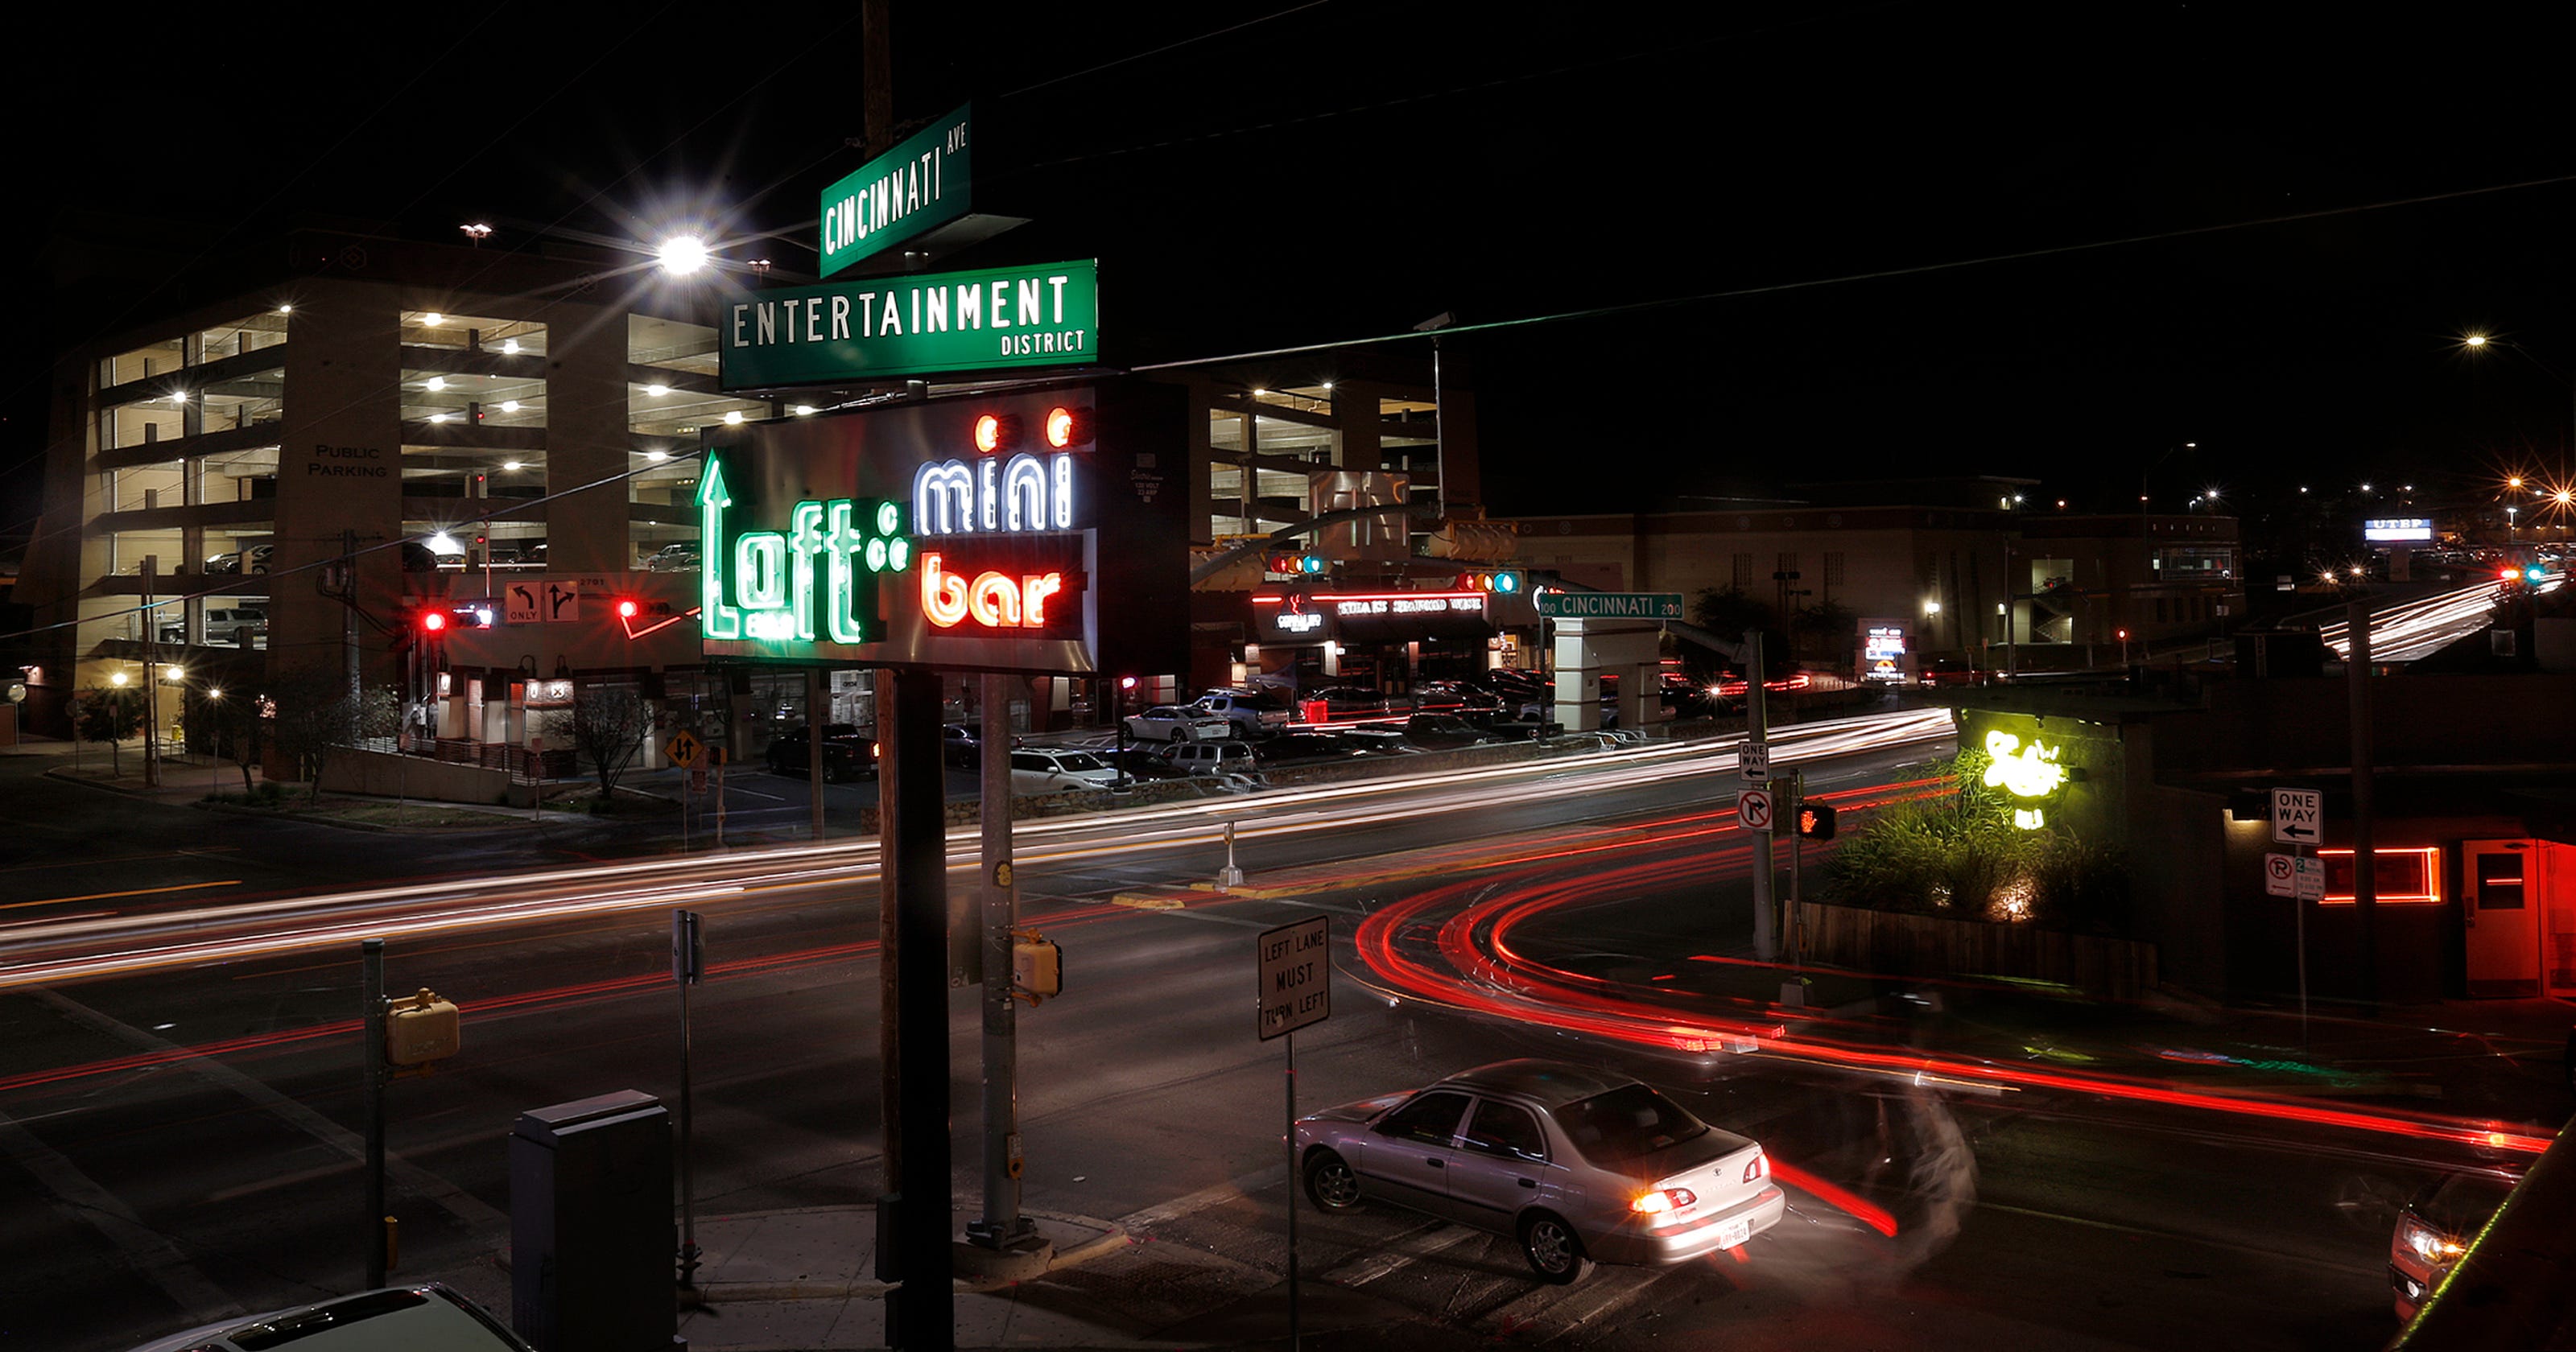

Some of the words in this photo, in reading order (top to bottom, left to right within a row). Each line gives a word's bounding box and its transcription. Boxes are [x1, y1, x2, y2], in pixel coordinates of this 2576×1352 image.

[825, 146, 940, 256] CINCINNATI
[947, 122, 967, 155] AVE
[733, 275, 1069, 348] ENTERTAINMENT
[1001, 329, 1085, 357] DISTRICT
[912, 407, 1073, 534] mini
[922, 553, 1060, 628] bar
[510, 611, 538, 620] ONLY
[1562, 596, 1653, 615] CINCINNATI
[1661, 604, 1681, 615] 200
[1743, 745, 1765, 755] ONE
[1743, 756, 1765, 766] WAY
[2279, 793, 2314, 808] ONE
[2279, 808, 2315, 822] WAY
[1265, 940, 1290, 962] LEFT
[1297, 930, 1324, 952] LANE
[1277, 962, 1313, 992] MUST
[1265, 1002, 1293, 1025] TURN
[1299, 991, 1325, 1014] LEFT
